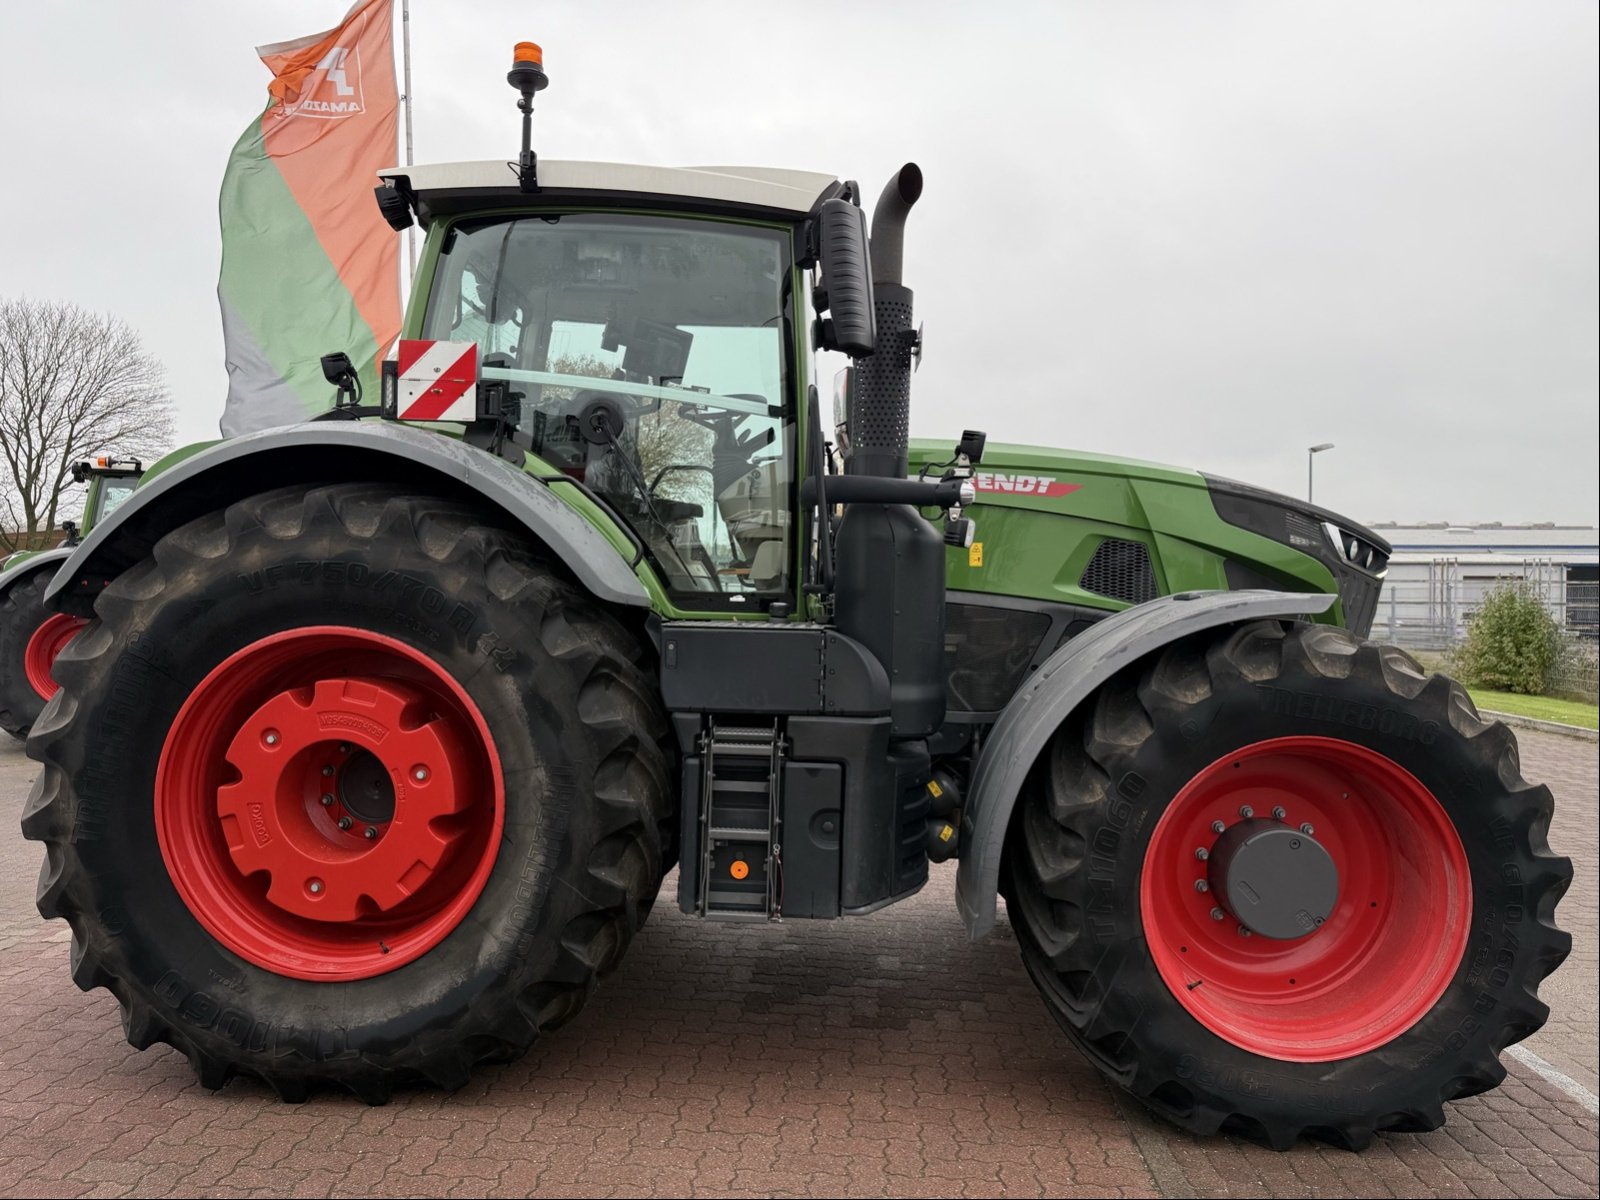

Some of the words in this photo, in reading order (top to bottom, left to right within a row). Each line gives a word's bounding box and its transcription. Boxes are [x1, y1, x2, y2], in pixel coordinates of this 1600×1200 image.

[971, 472, 1057, 494] ENDT
[238, 563, 286, 596] VF
[296, 560, 447, 616] 750/70
[447, 601, 479, 635] R
[1255, 683, 1440, 745] TRELLEBORG
[1086, 771, 1148, 944] TM1060
[152, 968, 361, 1063] TM1060
